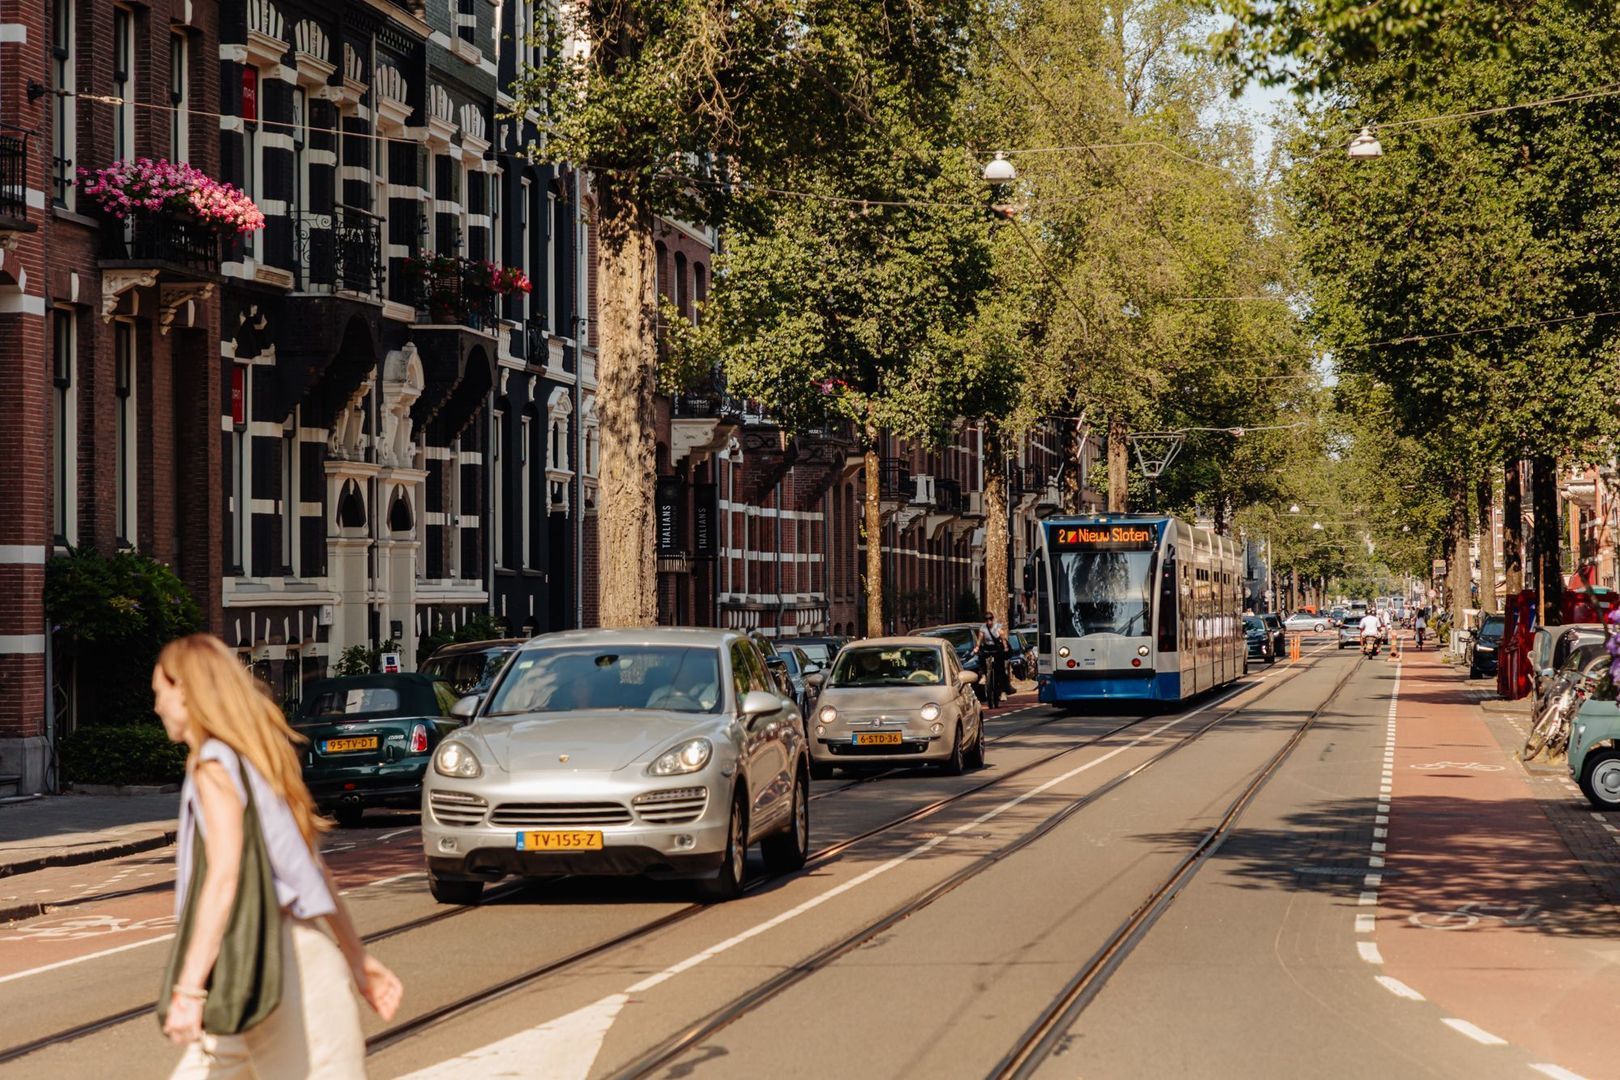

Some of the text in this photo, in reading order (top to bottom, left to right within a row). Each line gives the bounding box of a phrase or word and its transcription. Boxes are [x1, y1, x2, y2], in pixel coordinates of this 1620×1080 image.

[662, 505, 671, 549] THALIANS
[698, 507, 708, 549] THALIANS
[1058, 528, 1149, 543] 2 Nieuw Sloten
[330, 738, 374, 750] 95-TV-DT
[860, 735, 898, 743] 6-STD-36
[533, 834, 595, 847] TV-155-Z
